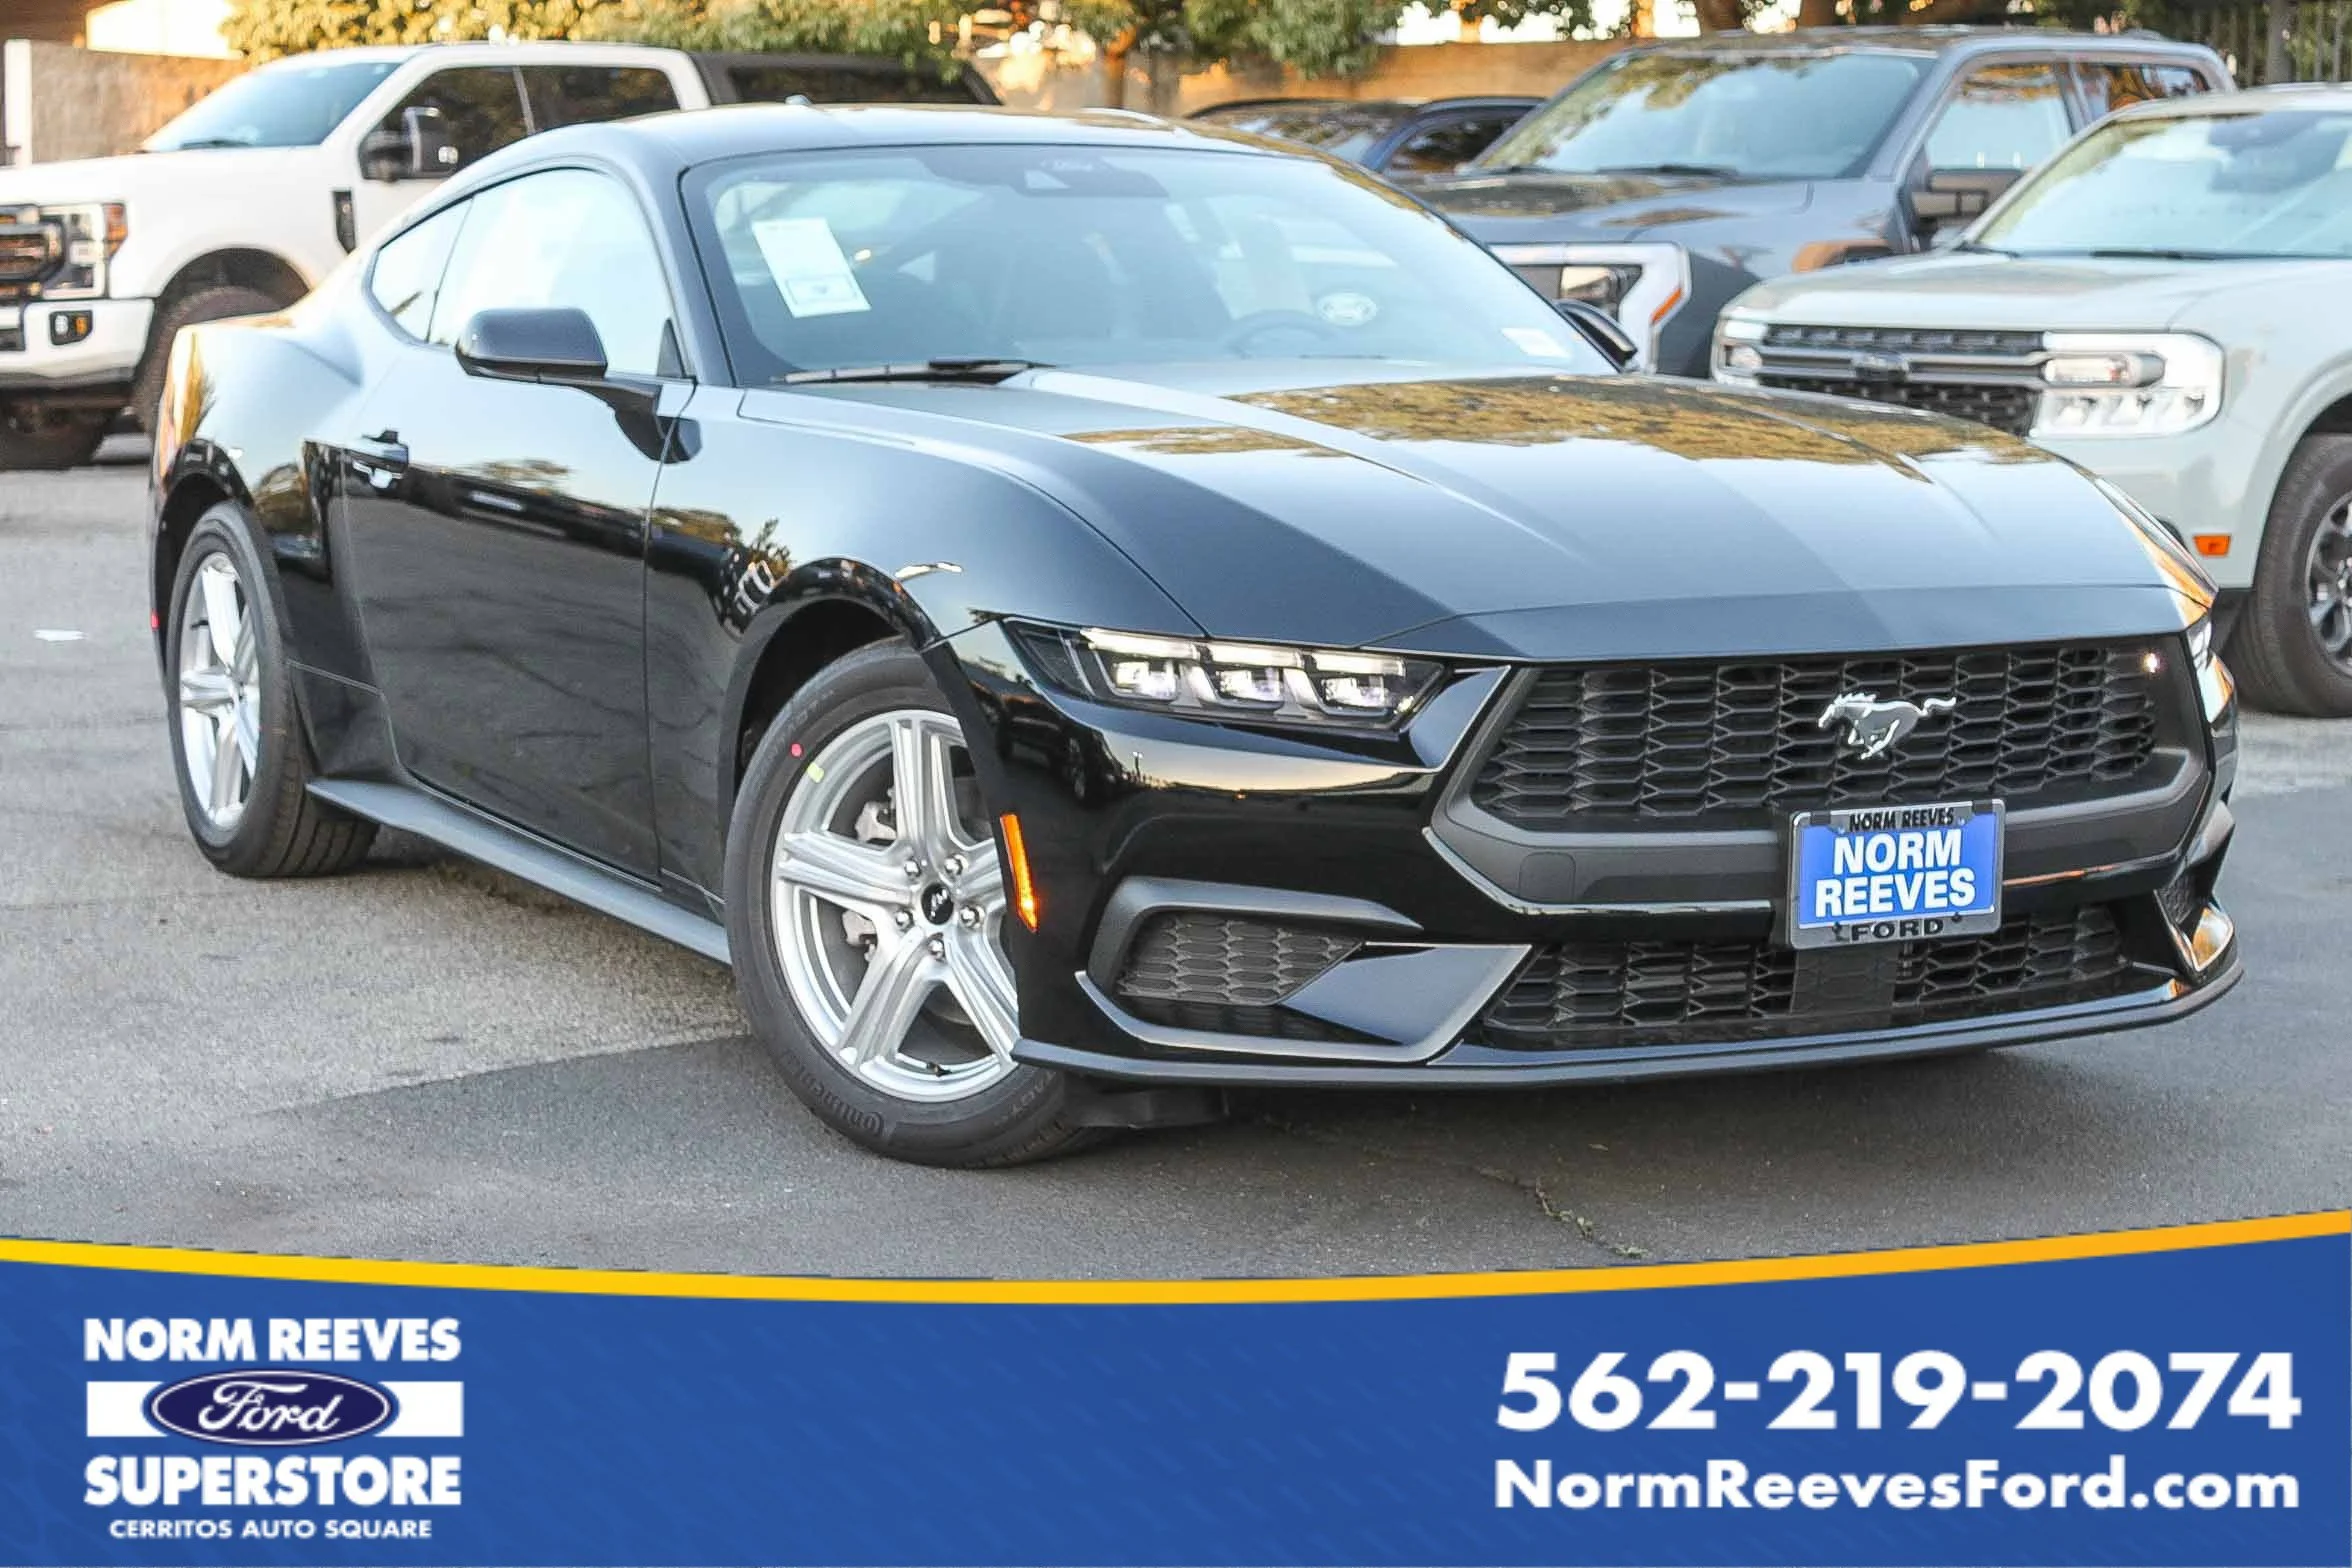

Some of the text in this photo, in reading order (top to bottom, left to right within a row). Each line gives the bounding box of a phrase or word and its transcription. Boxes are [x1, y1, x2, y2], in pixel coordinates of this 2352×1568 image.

[1849, 807, 1954, 831] NORM REEVES
[1834, 829, 1962, 875] NORM
[1815, 868, 1975, 918] REEVES
[1851, 918, 1944, 941] FORD
